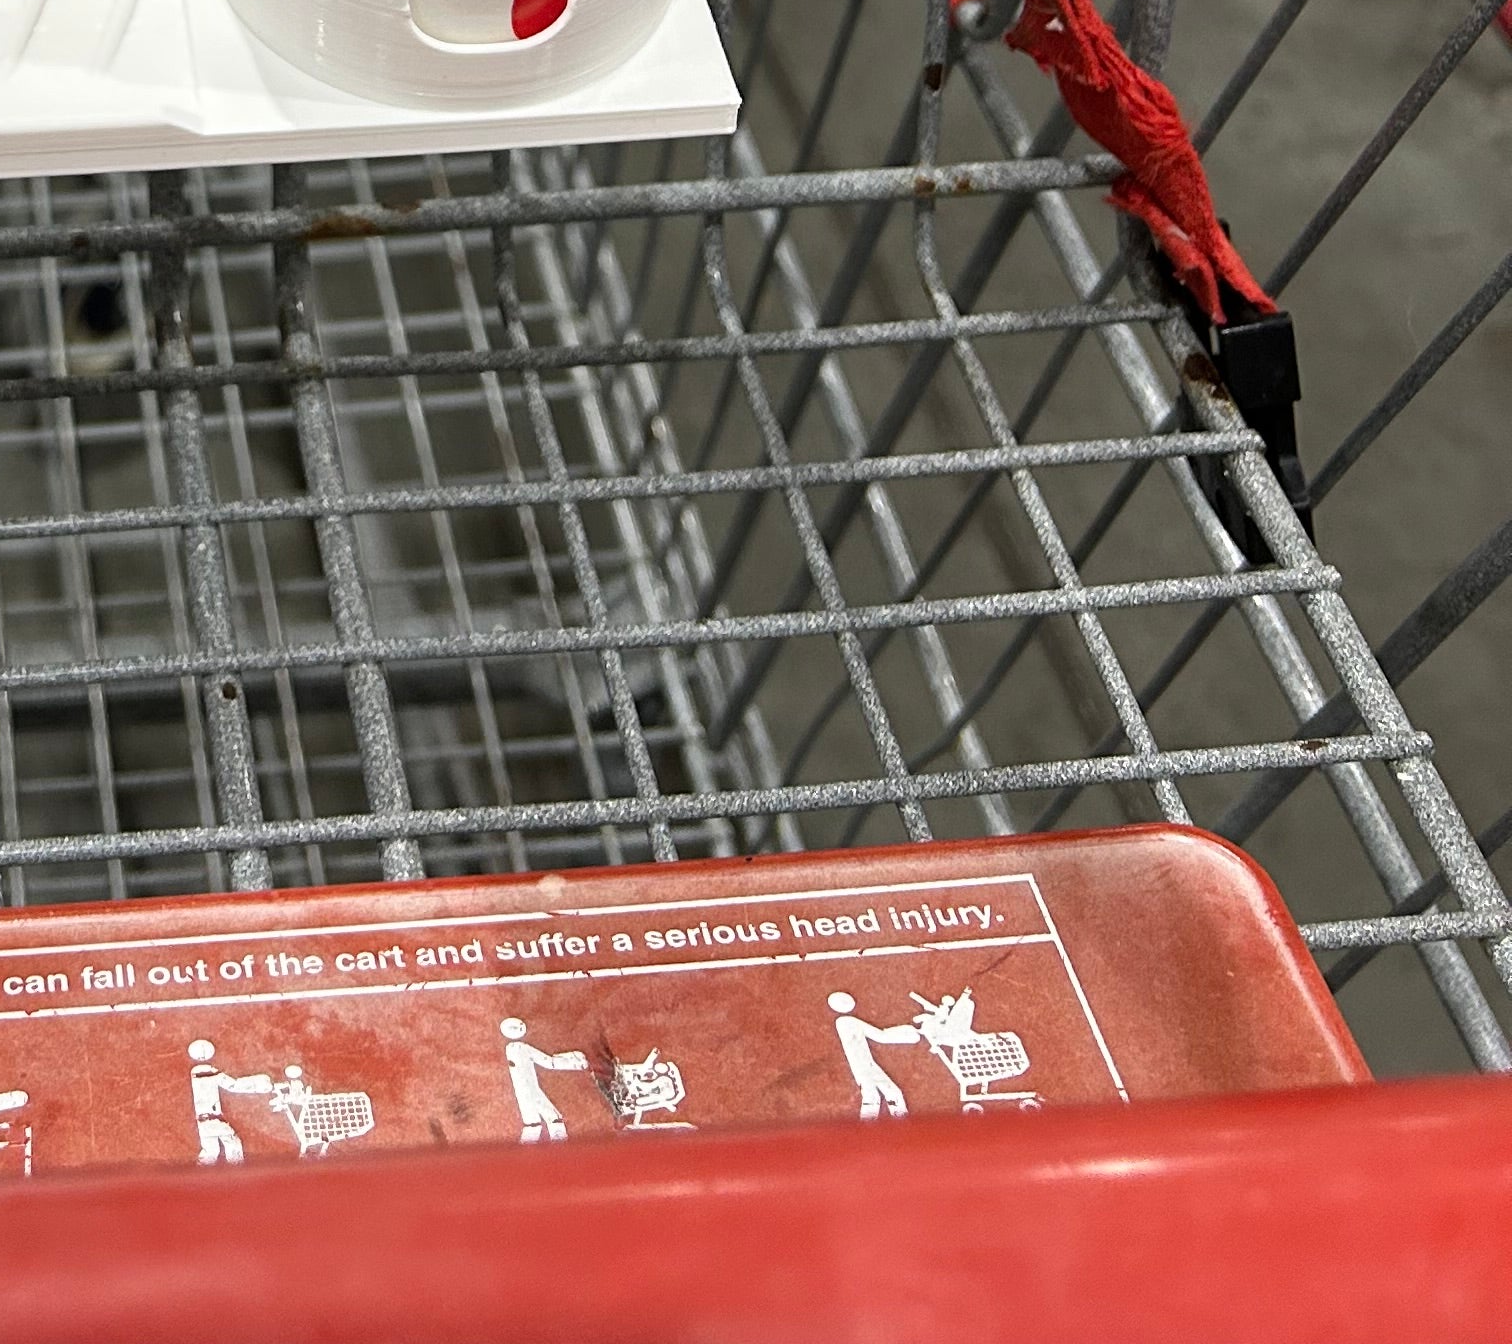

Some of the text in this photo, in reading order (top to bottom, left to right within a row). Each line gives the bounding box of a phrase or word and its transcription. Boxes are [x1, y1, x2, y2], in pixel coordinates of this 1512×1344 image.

[3, 971, 69, 995] can
[81, 963, 136, 989] fall
[148, 959, 210, 985] out
[219, 954, 255, 980] of
[265, 951, 324, 977] the
[335, 944, 407, 972] cart
[416, 939, 484, 967] and
[495, 932, 601, 960] suffer
[611, 931, 634, 952] a
[644, 920, 781, 950] serious
[788, 908, 881, 938] head
[888, 903, 1005, 934] injury.
